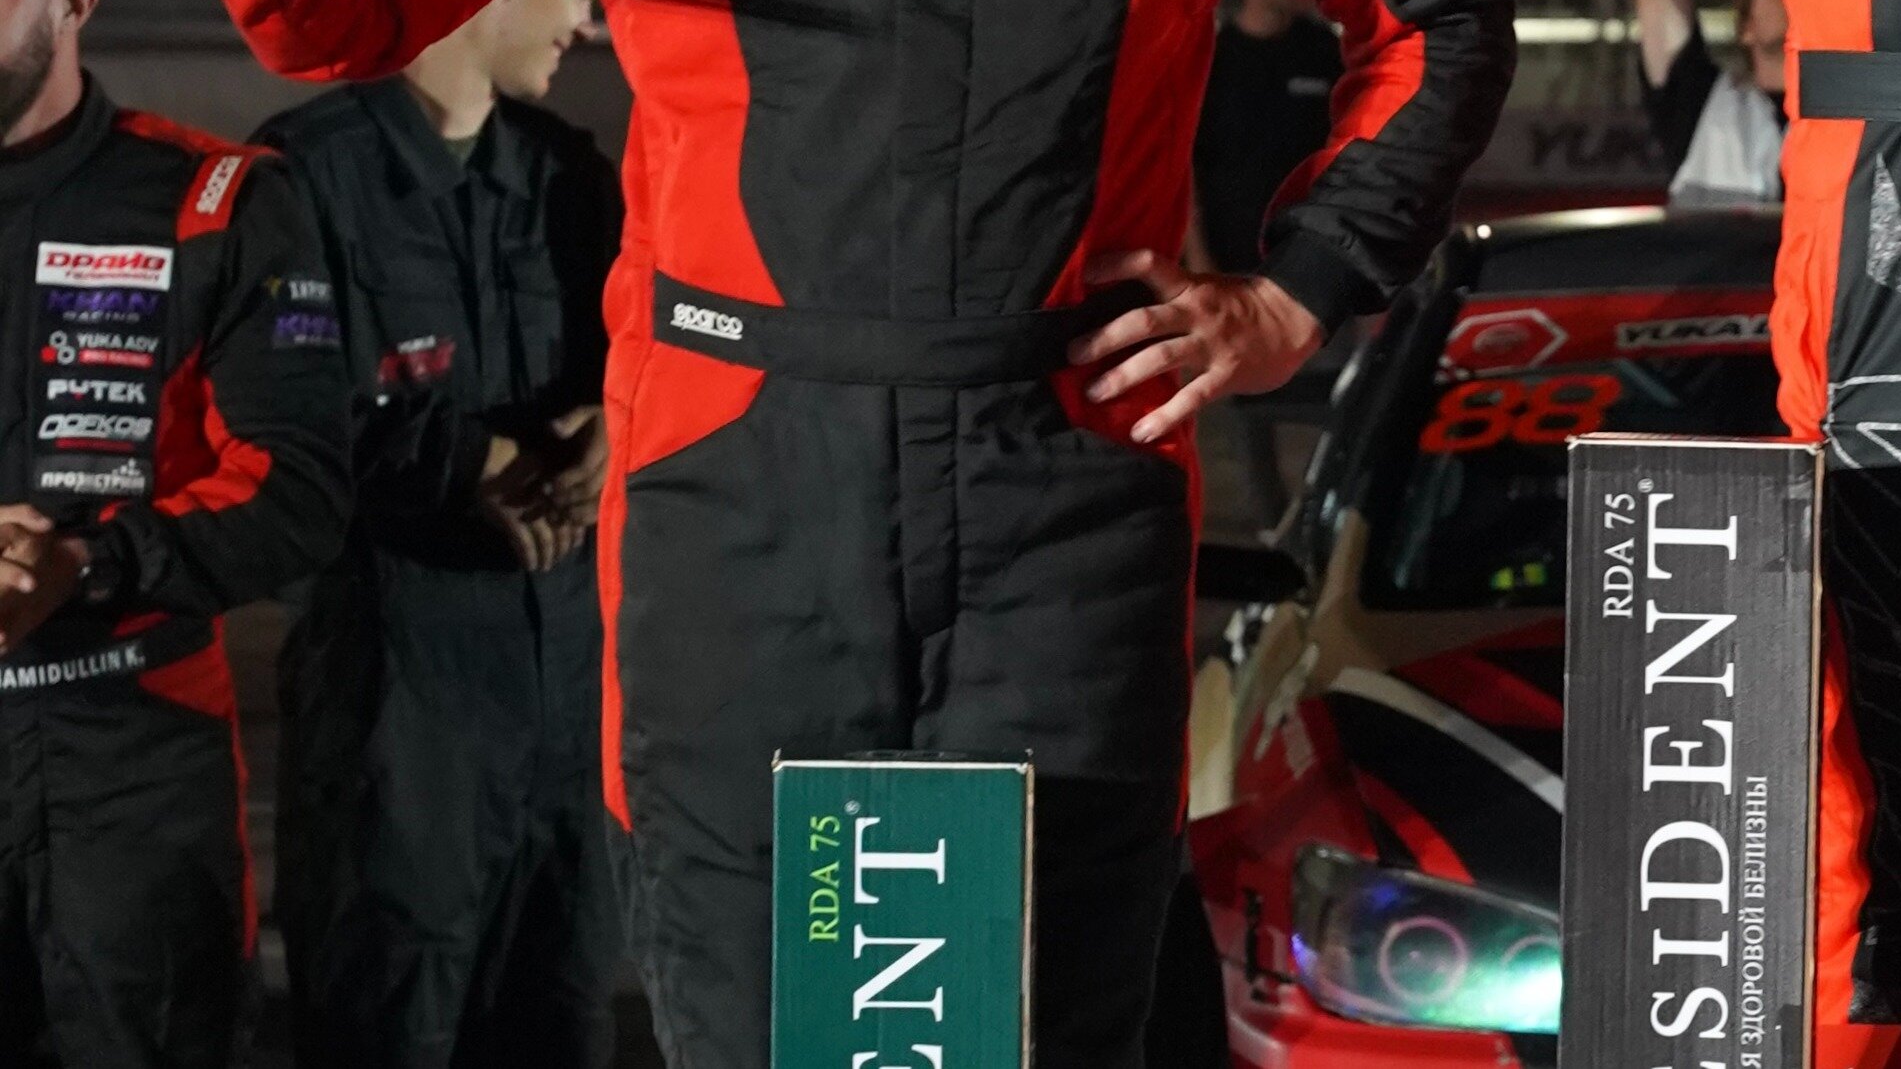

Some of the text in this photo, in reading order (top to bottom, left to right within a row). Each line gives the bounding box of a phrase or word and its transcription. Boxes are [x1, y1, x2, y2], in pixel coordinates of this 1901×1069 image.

[77, 332, 123, 350] YUKA
[670, 302, 744, 341] sparco
[1419, 374, 1623, 454] 88
[1602, 493, 1636, 619] RDA 75
[0, 650, 121, 690] AMIDULLIN
[1640, 492, 1738, 1069] SIDENT
[1744, 776, 1768, 899] БЕЛИЗНЫ
[808, 815, 841, 943] RDA 75
[1738, 906, 1767, 1047] ЗДОРОВОЙ
